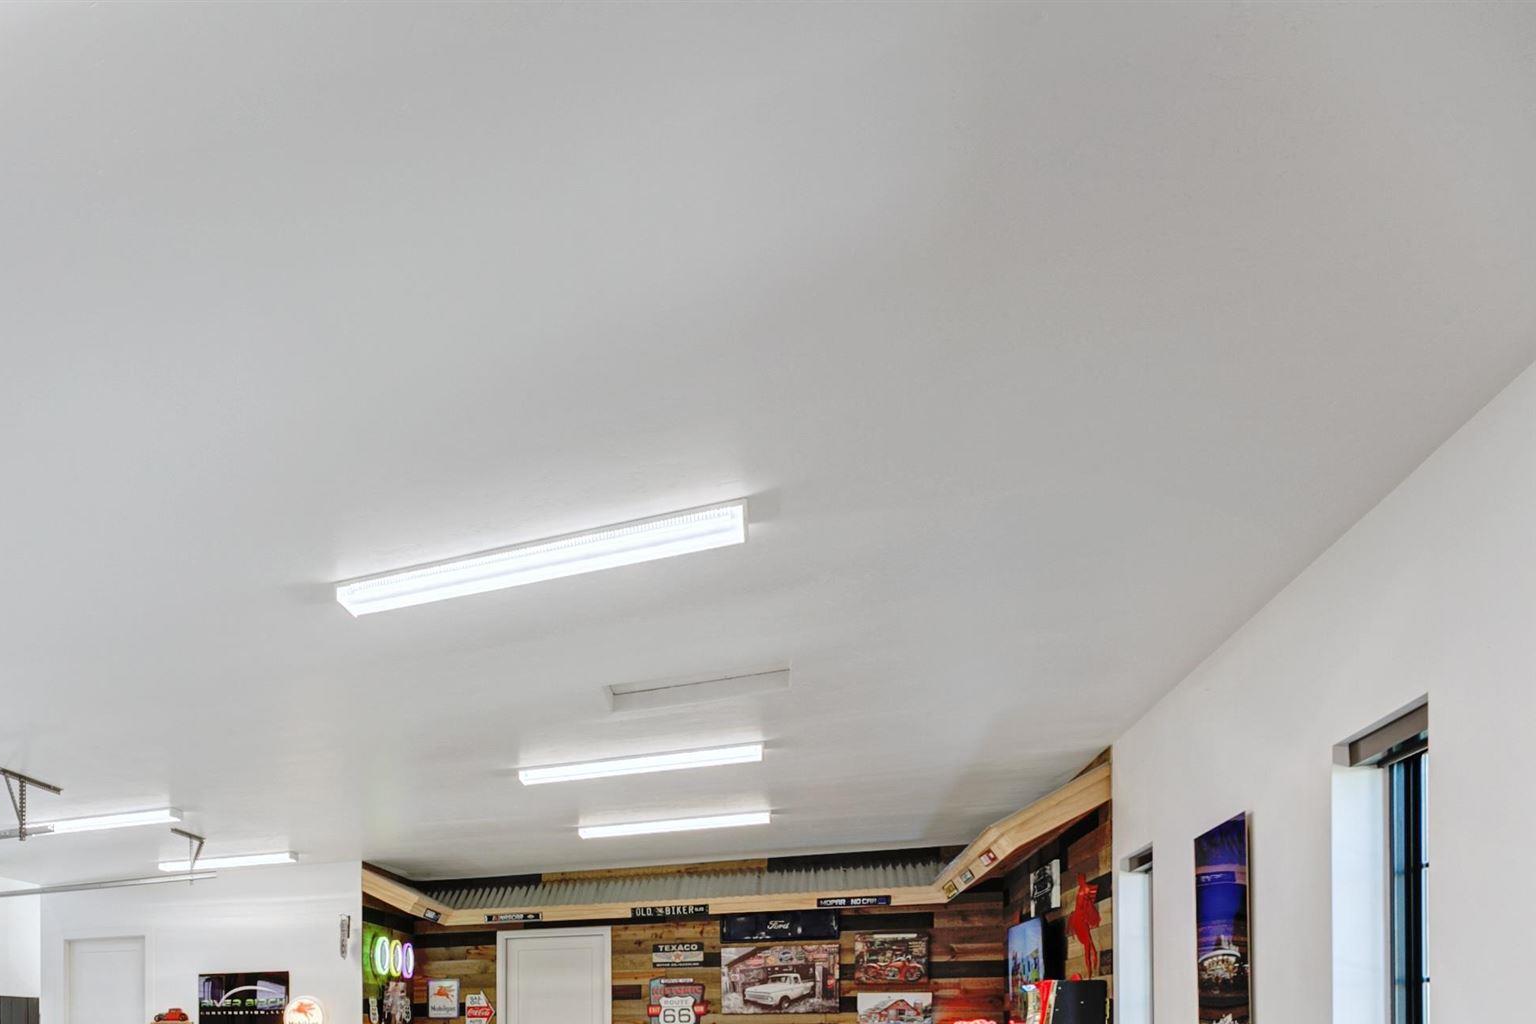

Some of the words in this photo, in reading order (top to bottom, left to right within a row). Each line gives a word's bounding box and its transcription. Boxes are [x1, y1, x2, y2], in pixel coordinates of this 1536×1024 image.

[664, 905, 694, 915] BIKER
[766, 920, 790, 930] Ford
[658, 943, 698, 952] TEXACO
[663, 1008, 691, 1023] 66
